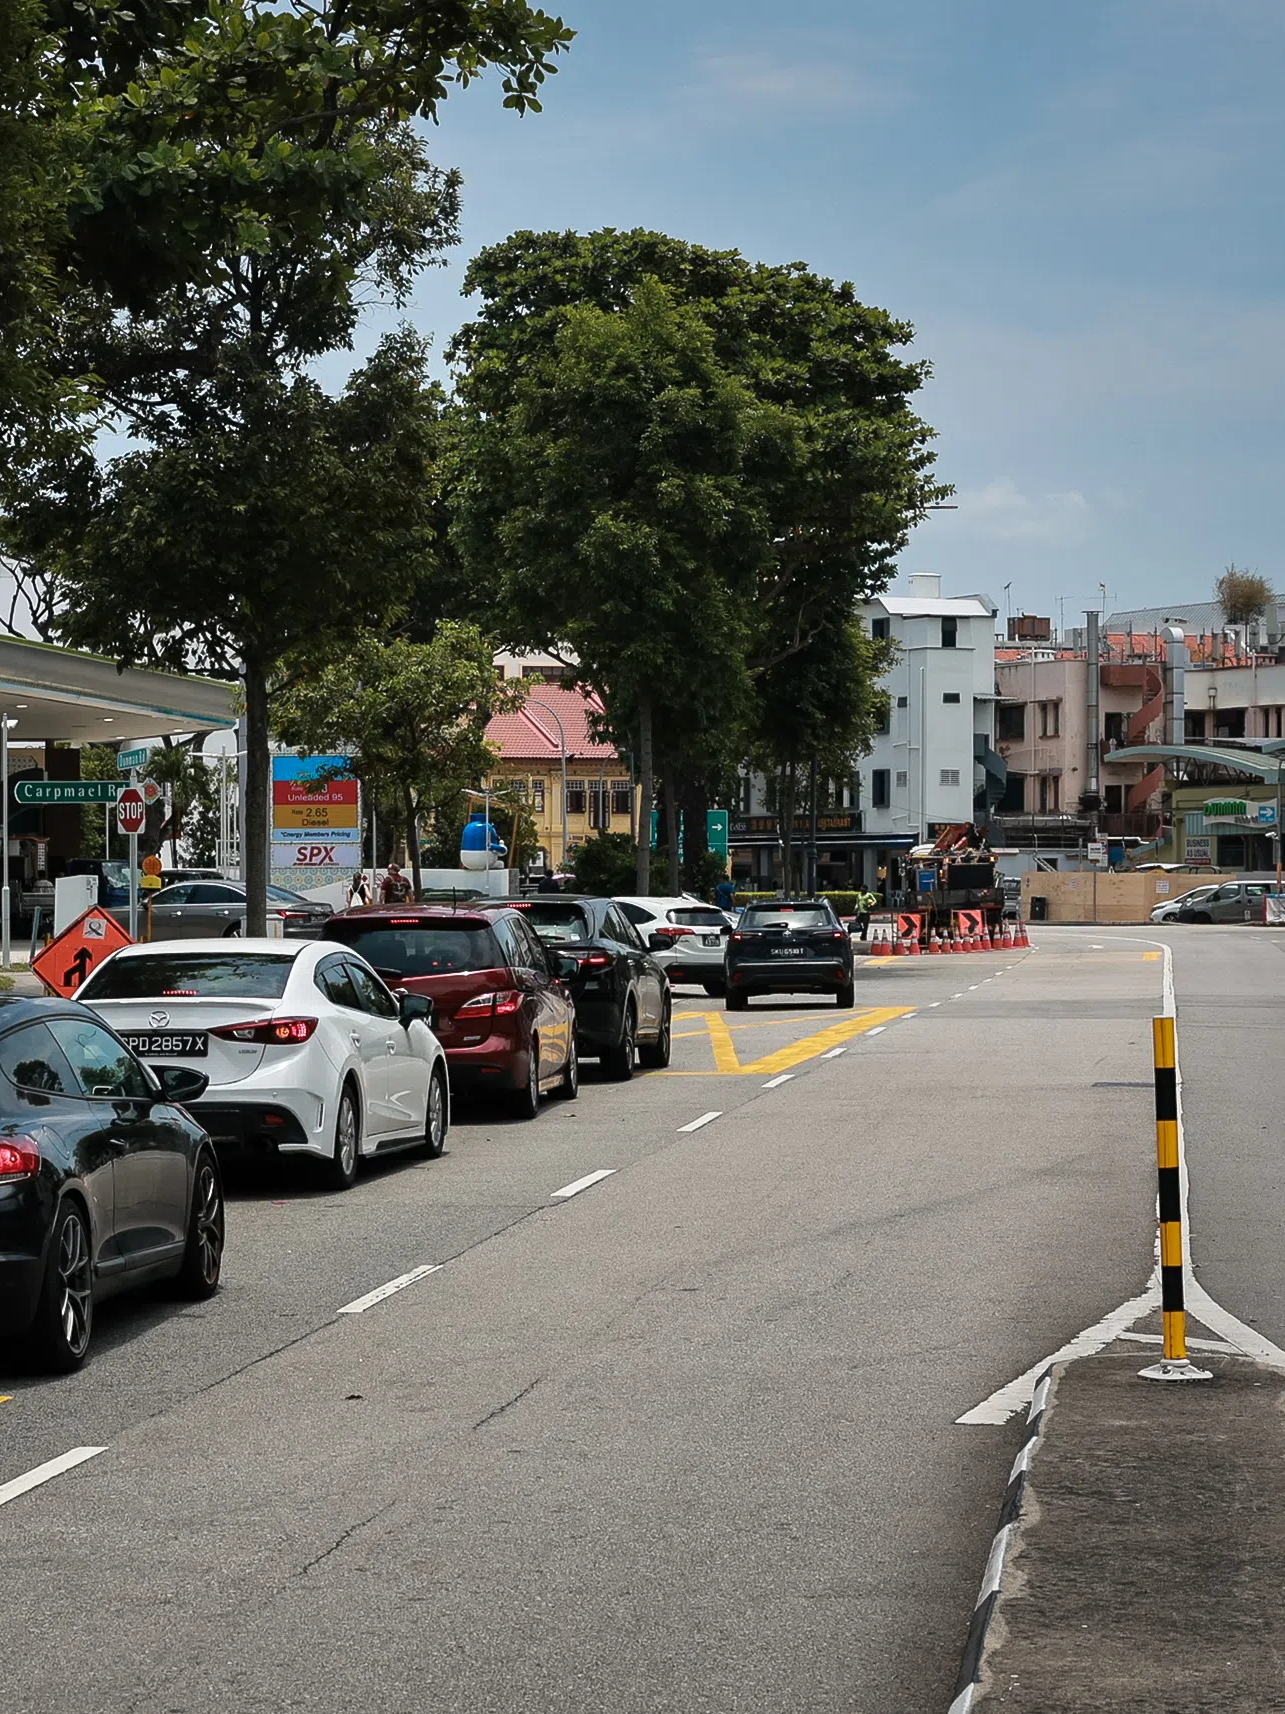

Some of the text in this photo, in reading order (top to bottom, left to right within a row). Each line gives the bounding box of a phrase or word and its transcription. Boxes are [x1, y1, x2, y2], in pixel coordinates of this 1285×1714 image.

[24, 784, 126, 800] Carpmael R
[287, 793, 343, 801] Unleaded 95
[119, 802, 143, 820] STOP
[306, 807, 328, 817] 2.65
[302, 818, 329, 827] Diesel
[1186, 838, 1210, 847] BUSINESS
[296, 845, 336, 866] SPX
[1186, 849, 1210, 857] AS USUAL
